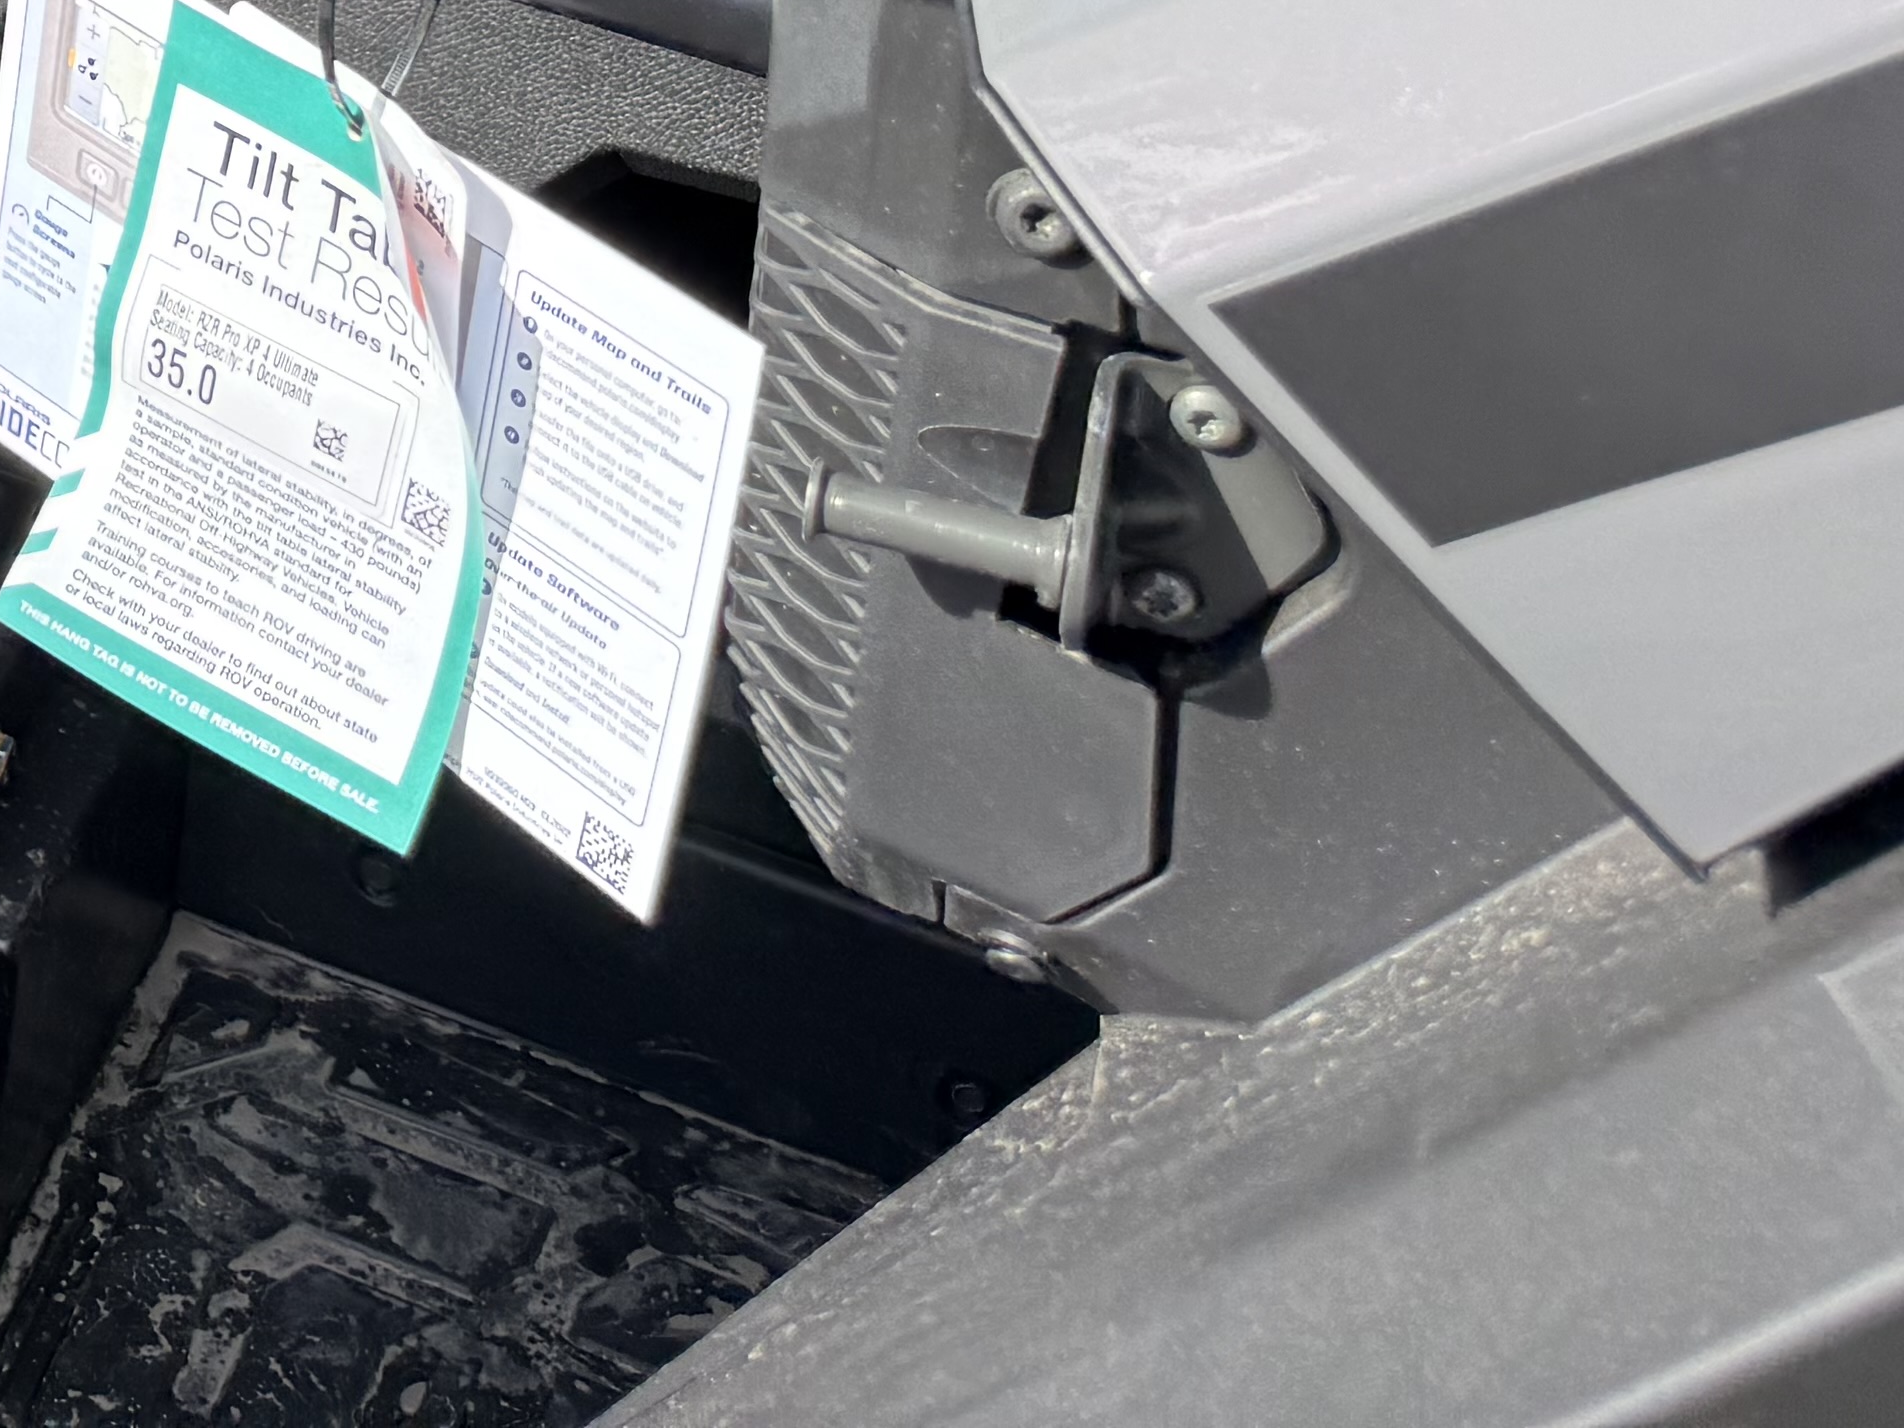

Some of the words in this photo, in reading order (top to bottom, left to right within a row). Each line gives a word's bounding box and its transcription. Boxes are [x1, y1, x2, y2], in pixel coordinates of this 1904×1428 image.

[186, 166, 296, 271] Test
[213, 120, 300, 212] Tilt
[147, 337, 218, 407] 35.0
[149, 309, 191, 347] Seating
[256, 363, 314, 408] Occupants
[155, 289, 195, 324] Model:
[198, 309, 222, 336] RZR
[225, 322, 241, 347] Pro
[245, 332, 261, 357] XP
[272, 348, 320, 388] Ultimate
[173, 229, 255, 288] Polaris
[262, 274, 383, 355] Industries
[390, 344, 426, 388] Inc.
[530, 290, 588, 335] Update
[591, 330, 627, 360] Map
[630, 357, 662, 383] and
[667, 377, 711, 415] Trails
[103, 502, 142, 529] affect
[144, 522, 186, 552] lateral
[120, 459, 145, 480] test
[147, 476, 160, 488] in
[163, 483, 183, 501] the
[273, 548, 331, 586] standard
[334, 580, 353, 597] for
[128, 434, 144, 448] as
[146, 444, 210, 485] measured
[212, 479, 228, 497] by
[232, 491, 252, 509] the
[255, 506, 342, 560] manufacturer
[344, 556, 356, 570] in
[132, 421, 186, 456] operator
[188, 453, 213, 472] and
[226, 475, 295, 518] passenger
[297, 513, 327, 537] load
[340, 539, 365, 559] 430
[366, 556, 421, 595] pounds)
[137, 394, 223, 450] Measurement
[225, 447, 240, 459] of
[242, 454, 282, 484] lateral
[342, 510, 355, 524] in
[358, 520, 414, 561] degrees,
[418, 556, 433, 569] of
[198, 444, 255, 482] standard
[322, 515, 369, 546] vehicle
[372, 538, 403, 566] (with
[406, 564, 423, 579] an
[81, 550, 127, 579] and/or
[97, 519, 147, 559] Training
[150, 552, 203, 587] courses
[205, 580, 220, 596] to
[222, 589, 260, 618] teach
[262, 611, 295, 636] ROV
[296, 632, 342, 666] driving
[344, 660, 366, 678] are
[109, 488, 192, 541] modification,
[196, 535, 277, 589] accessories,
[280, 583, 307, 604] and
[309, 597, 358, 635] loading
[361, 630, 386, 649] can
[203, 491, 229, 511] with
[232, 506, 253, 525] the
[276, 531, 308, 557] table
[311, 552, 352, 582] lateral
[355, 579, 407, 616] stability
[344, 600, 390, 636] Vehicle
[546, 573, 620, 631] Software
[65, 583, 81, 596] or
[82, 590, 117, 617] local
[117, 610, 149, 635] laws
[151, 631, 217, 675] regarding
[219, 665, 253, 690] ROV
[253, 686, 321, 730] operation.
[72, 568, 115, 600] Check
[118, 596, 146, 617] with
[148, 612, 181, 634] your
[182, 630, 226, 659] dealer
[228, 653, 243, 668] to
[245, 662, 273, 685] find
[274, 681, 298, 699] out
[300, 694, 341, 723] about
[343, 718, 378, 743] state
[154, 569, 177, 588] For
[179, 585, 255, 633] information
[258, 628, 310, 663] contact
[311, 657, 343, 680] your
[345, 677, 389, 706] dealer
[560, 610, 607, 650] Update
[18, 599, 52, 629] THIS
[49, 620, 91, 652] HANG
[92, 644, 120, 669] TAG
[119, 661, 136, 678] IS
[135, 670, 168, 695] NOT
[168, 688, 189, 708] TO
[188, 700, 211, 720] BE
[209, 712, 281, 758] REMOVED
[280, 751, 340, 792] BEFORE
